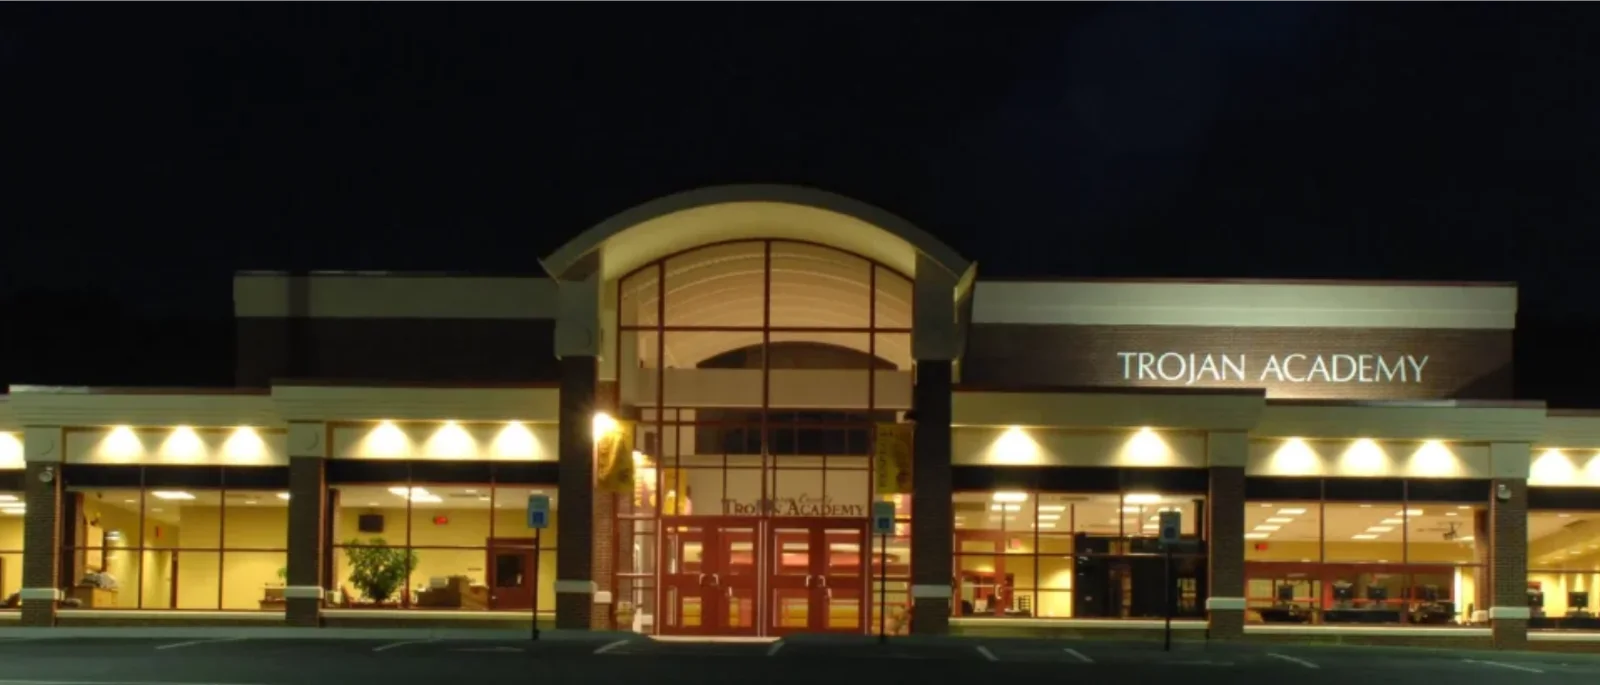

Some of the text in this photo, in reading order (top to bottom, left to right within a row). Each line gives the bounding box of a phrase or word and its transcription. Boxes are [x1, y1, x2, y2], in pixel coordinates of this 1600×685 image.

[1117, 352, 1428, 385] TROJAN ACADEMY
[721, 498, 781, 515] TRON
[787, 499, 863, 516] ACADEMY
